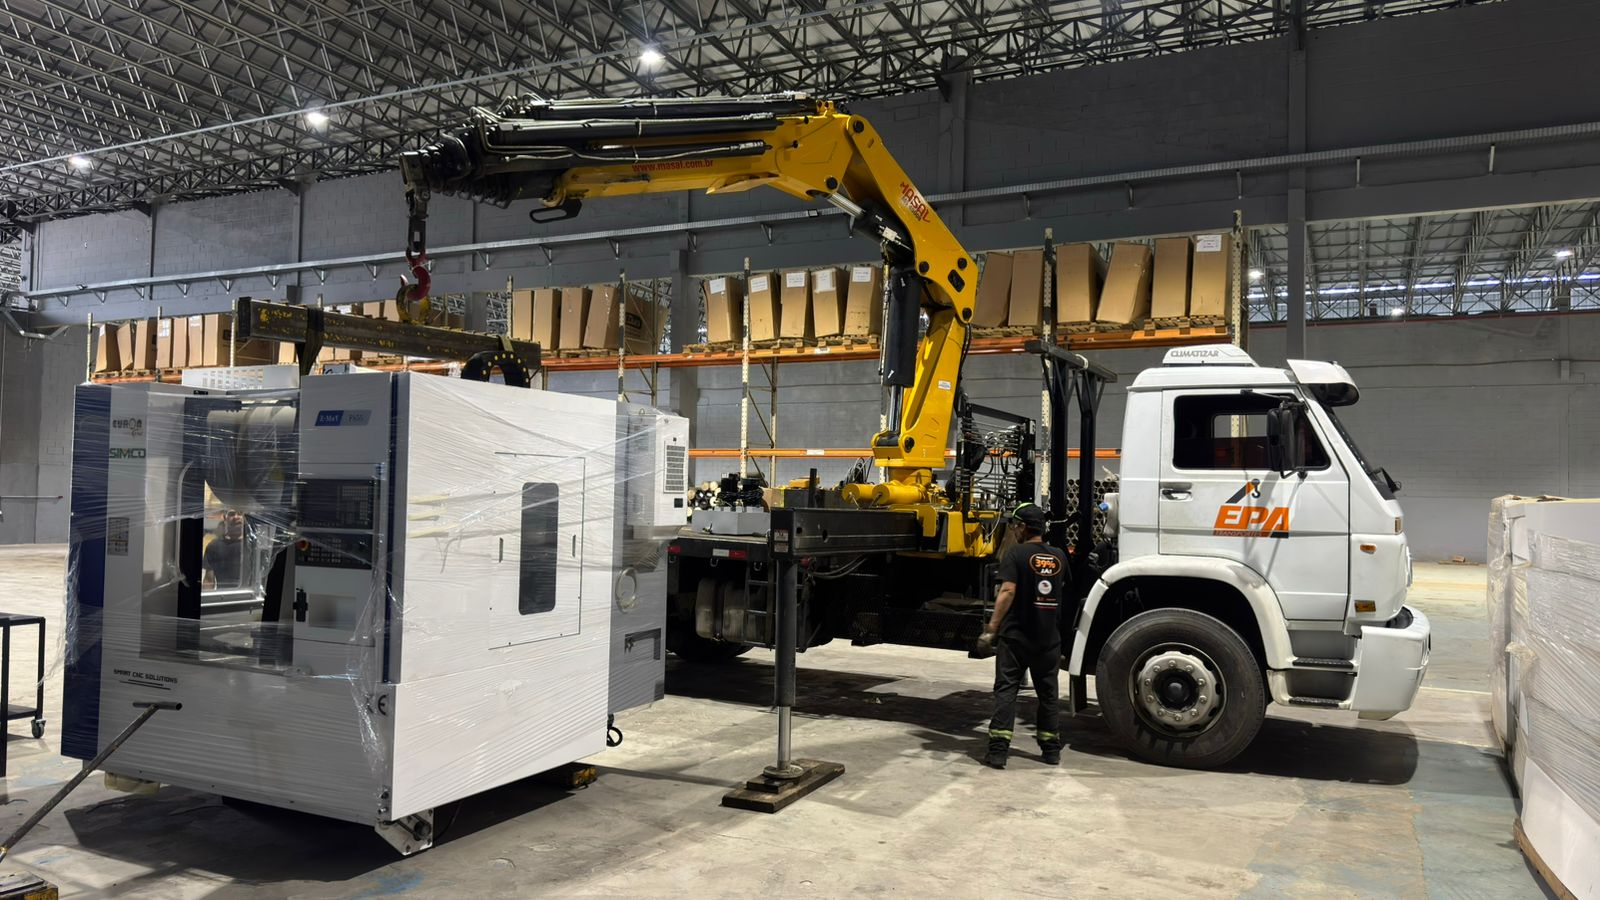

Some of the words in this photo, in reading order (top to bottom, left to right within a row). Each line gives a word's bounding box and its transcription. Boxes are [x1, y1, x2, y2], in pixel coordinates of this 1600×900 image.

[632, 160, 714, 172] www.masal.com.br
[900, 182, 930, 222] MASAL
[1170, 350, 1220, 358] CLIMATIZAR
[109, 448, 147, 459] SIMCO
[1214, 506, 1290, 531] EPA
[1035, 559, 1056, 569] 39%
[132, 671, 144, 679] CNC
[145, 674, 178, 684] SOLUTIONS
